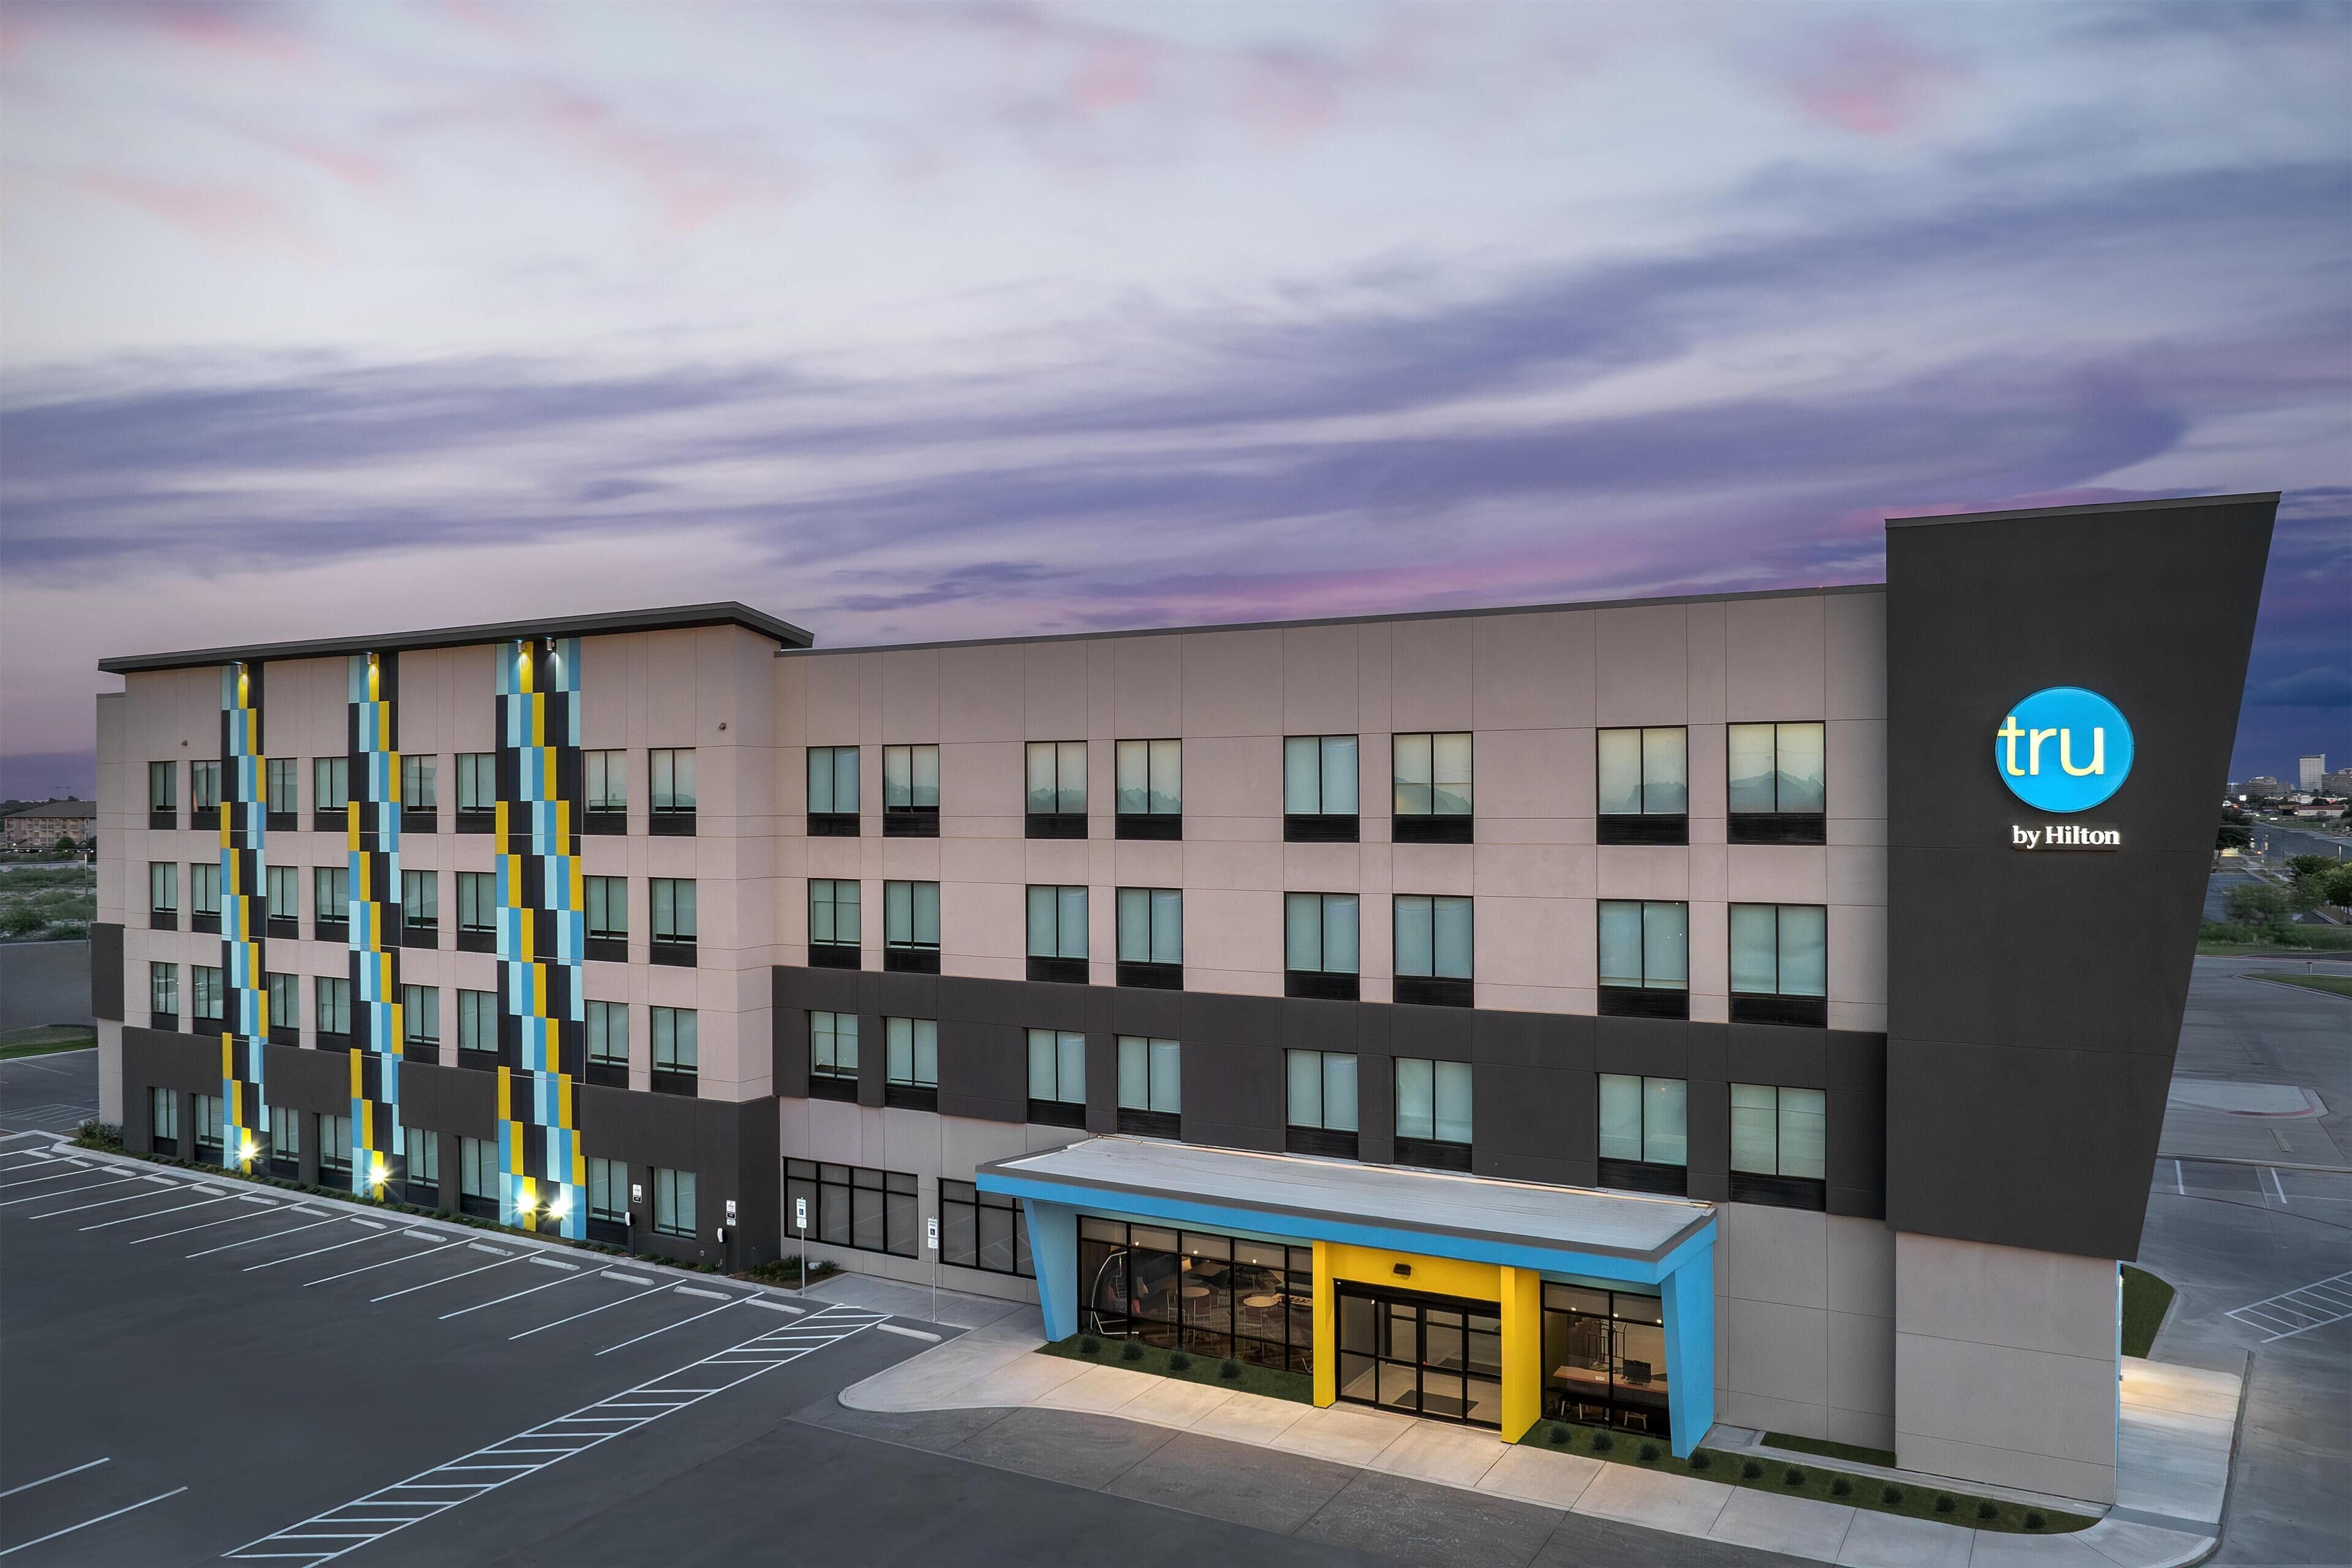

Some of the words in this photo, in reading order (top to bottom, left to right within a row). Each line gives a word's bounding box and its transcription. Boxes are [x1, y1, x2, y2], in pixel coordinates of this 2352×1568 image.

[1997, 716, 2104, 776] tru
[2012, 825, 2041, 849] by
[2045, 826, 2120, 845] Hilton
